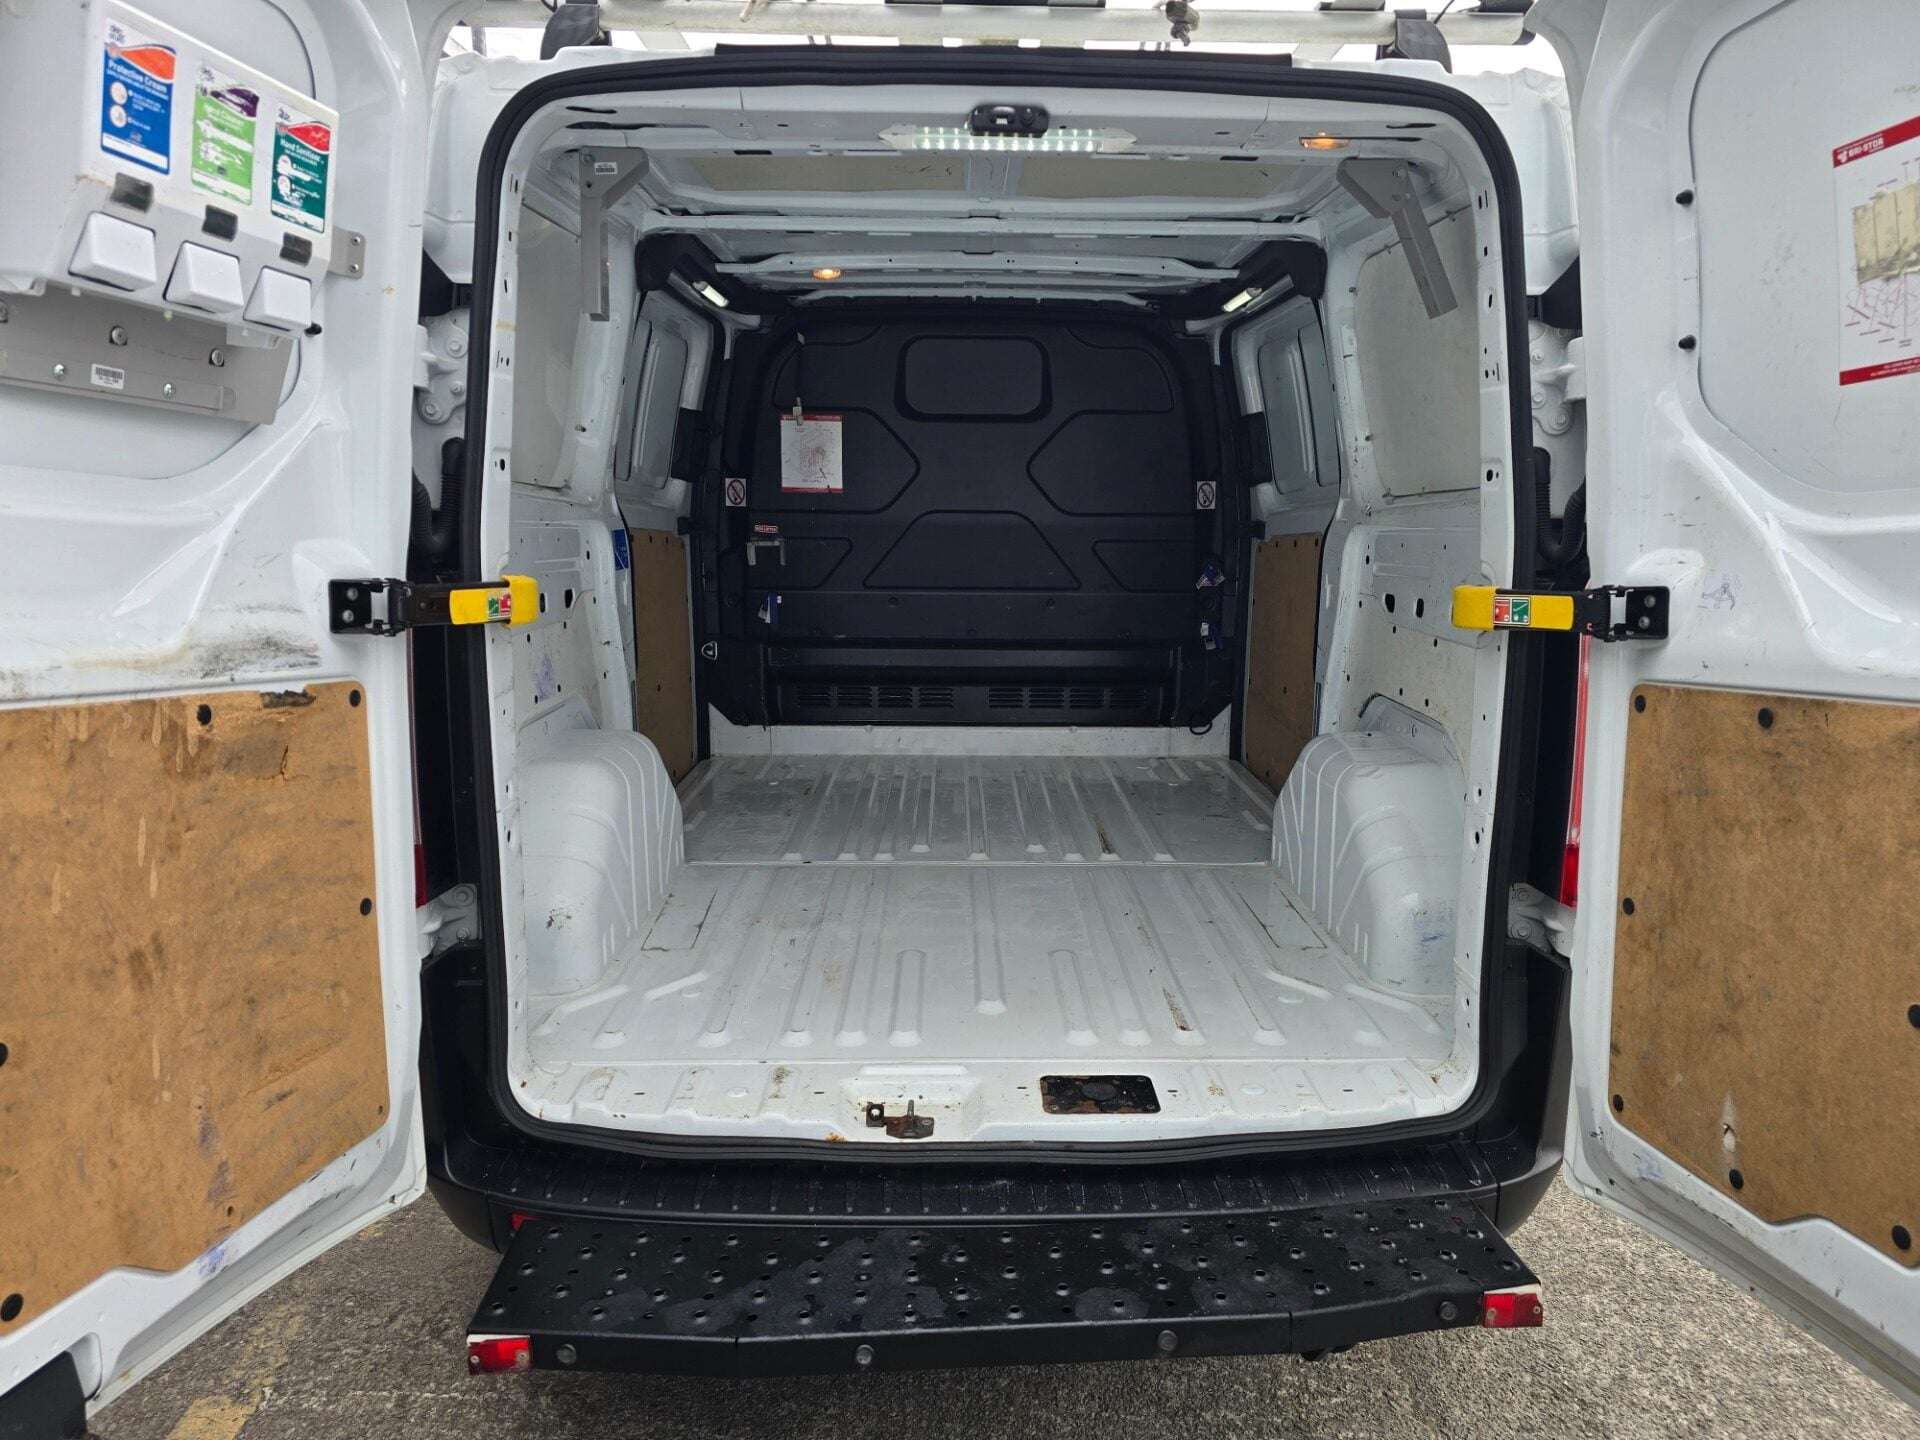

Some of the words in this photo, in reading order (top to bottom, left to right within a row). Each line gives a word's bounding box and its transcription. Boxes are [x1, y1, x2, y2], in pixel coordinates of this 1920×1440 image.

[108, 60, 145, 83] Protective
[144, 75, 168, 94] Cream
[280, 137, 296, 152] Hand
